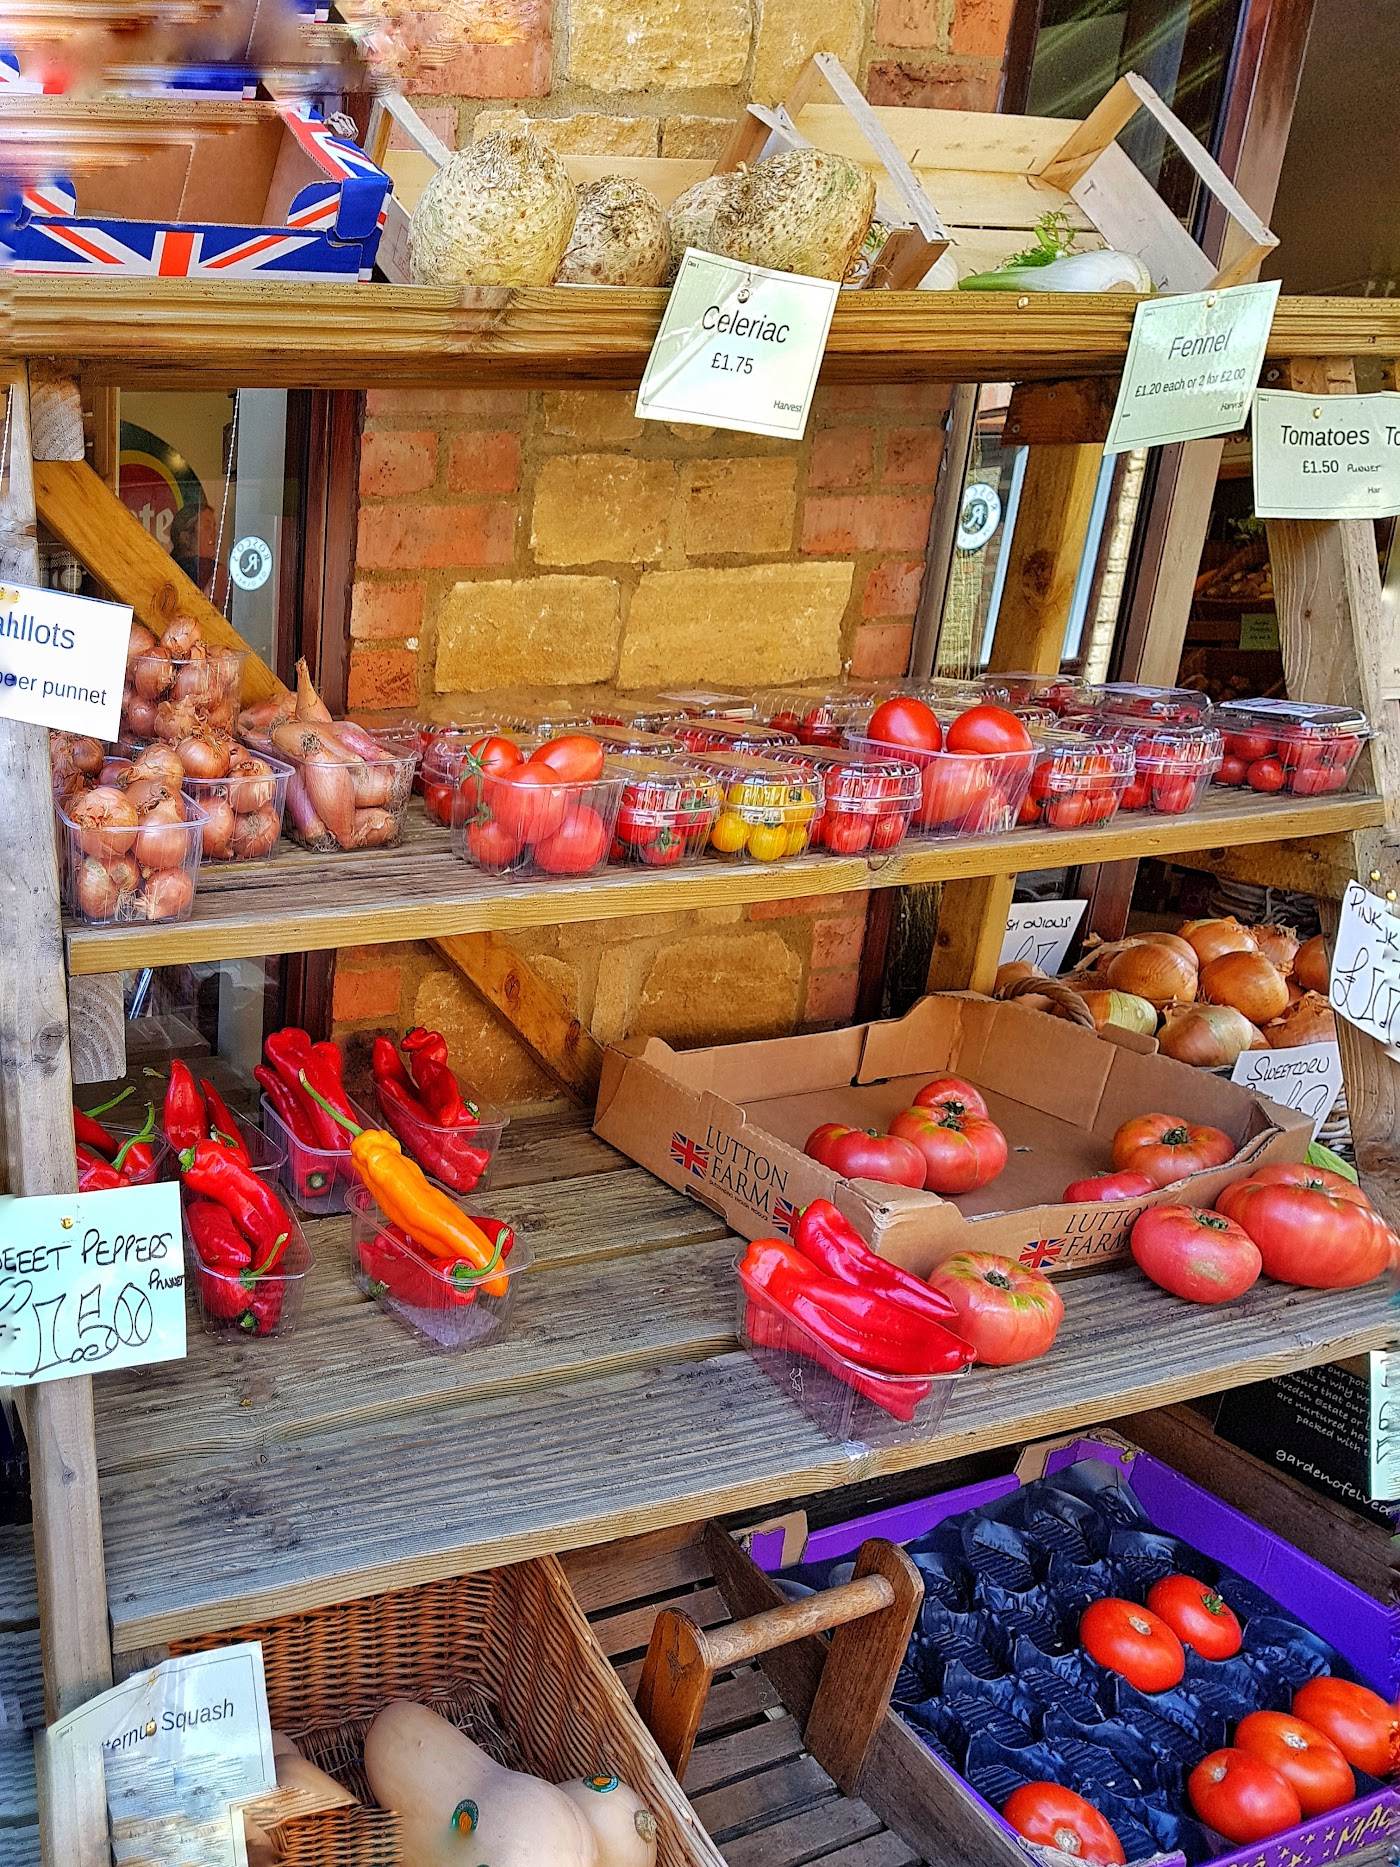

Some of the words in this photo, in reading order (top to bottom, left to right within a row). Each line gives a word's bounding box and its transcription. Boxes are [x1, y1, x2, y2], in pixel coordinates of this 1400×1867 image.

[702, 305, 790, 343] Celeriac
[1168, 327, 1233, 360] Fennel
[711, 352, 754, 375] £1.75
[1135, 382, 1162, 398] £1.20
[1163, 378, 1186, 393] each
[1187, 377, 1198, 389] or
[1199, 374, 1206, 387] 2
[1207, 371, 1220, 385] for
[1219, 368, 1246, 383] £2.00
[773, 400, 803, 413] Harvest
[1281, 425, 1370, 446] Tomatoes
[1303, 460, 1339, 473] £1.50
[43, 679, 107, 706] punnet
[1023, 915, 1072, 929] ONIONS
[1349, 886, 1383, 931] PINK
[705, 1125, 789, 1193] LUTTON
[711, 1155, 770, 1214] FARM
[1065, 1200, 1158, 1234] LUTTO
[82, 1228, 173, 1266] PEPPERS
[1276, 1392, 1293, 1405] are
[1320, 1386, 1344, 1404] that
[1345, 1401, 1366, 1414] our
[1329, 1379, 1354, 1399] why
[1314, 1397, 1349, 1420] Estate
[1350, 1417, 1363, 1427] or
[1295, 1414, 1335, 1439] packed
[1336, 1435, 1361, 1453] with
[161, 1698, 235, 1732] Squash
